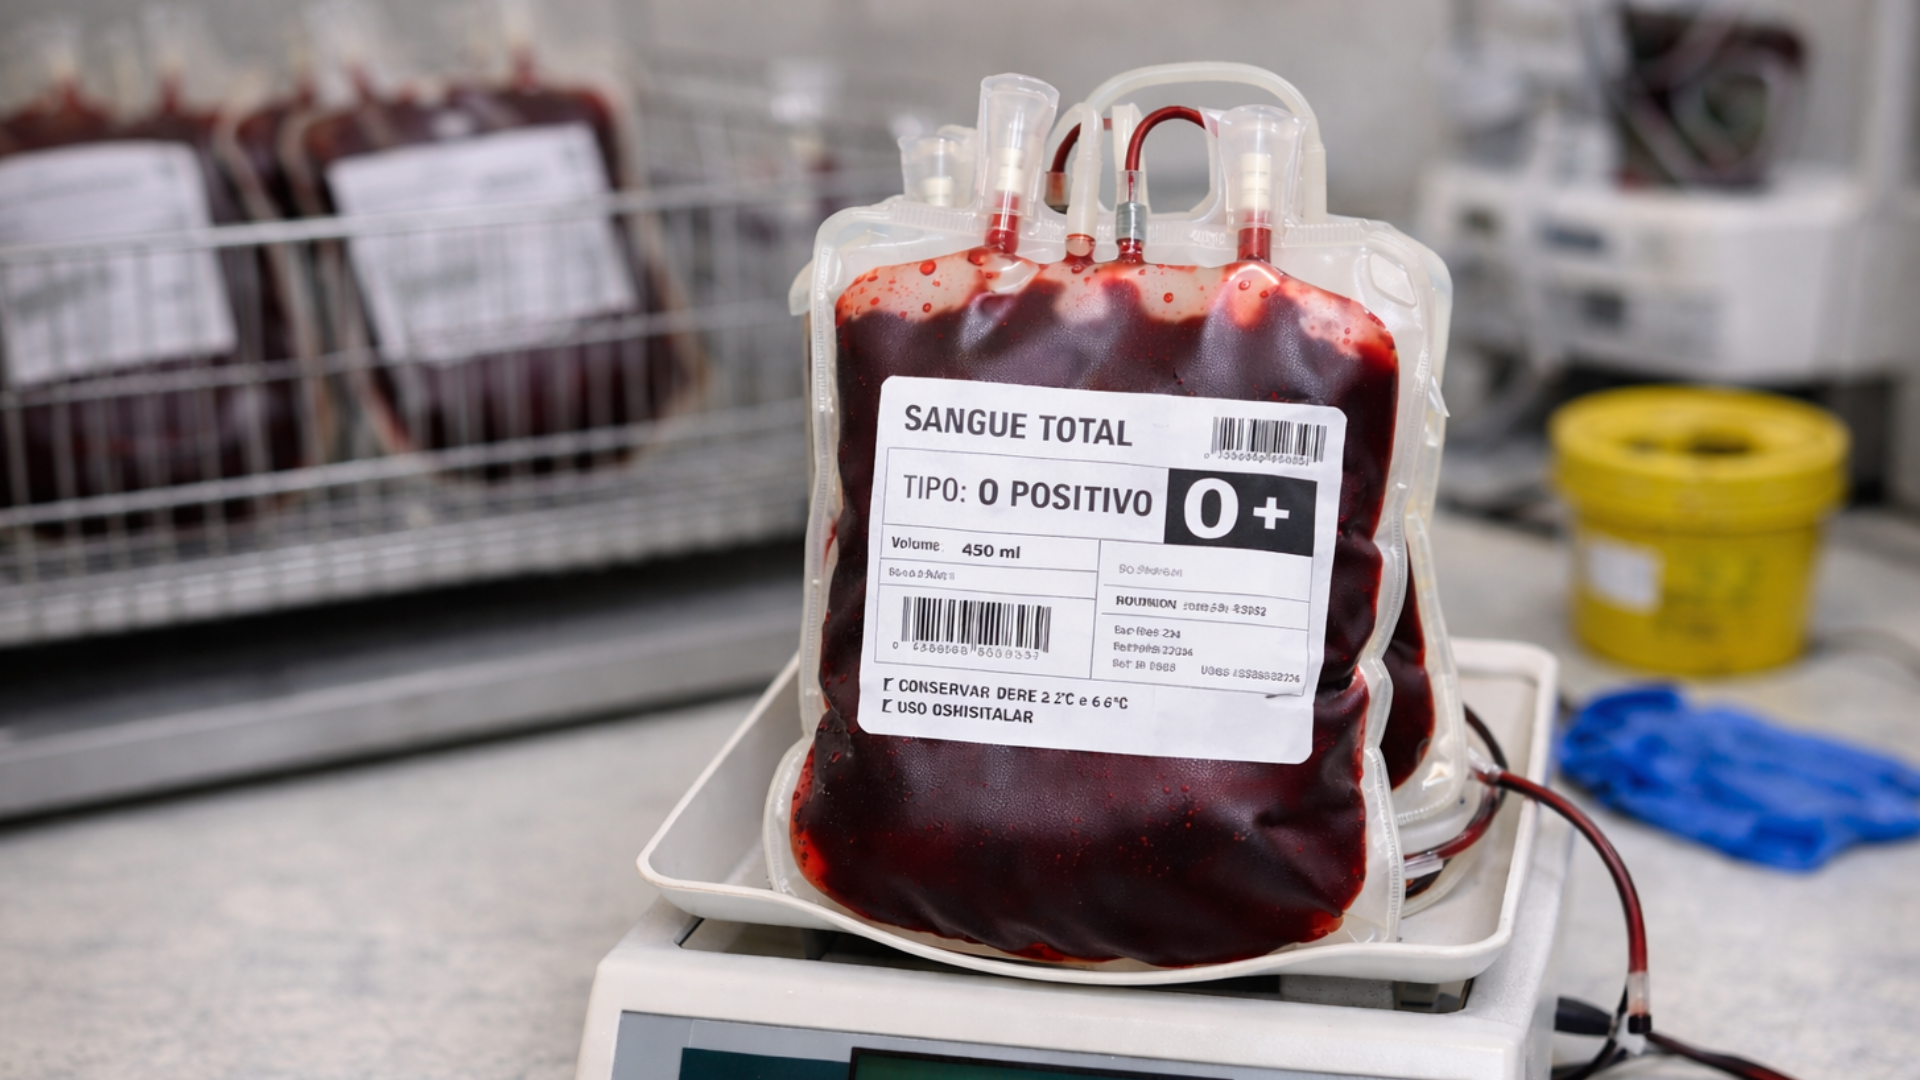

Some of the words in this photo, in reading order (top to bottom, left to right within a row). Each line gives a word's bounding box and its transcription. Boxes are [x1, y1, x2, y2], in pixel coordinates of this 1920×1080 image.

[904, 404, 1028, 439] SANGUE
[1039, 414, 1133, 447] TOTAL
[904, 474, 967, 503] TIPO:
[978, 478, 999, 505] O
[1010, 480, 1153, 517] POSITIVO
[962, 543, 995, 558] 450
[999, 546, 1021, 559] ml
[898, 678, 990, 699] CONSERVAR
[997, 686, 1038, 703] DERE
[1079, 696, 1088, 706] e
[898, 701, 928, 715] USO
